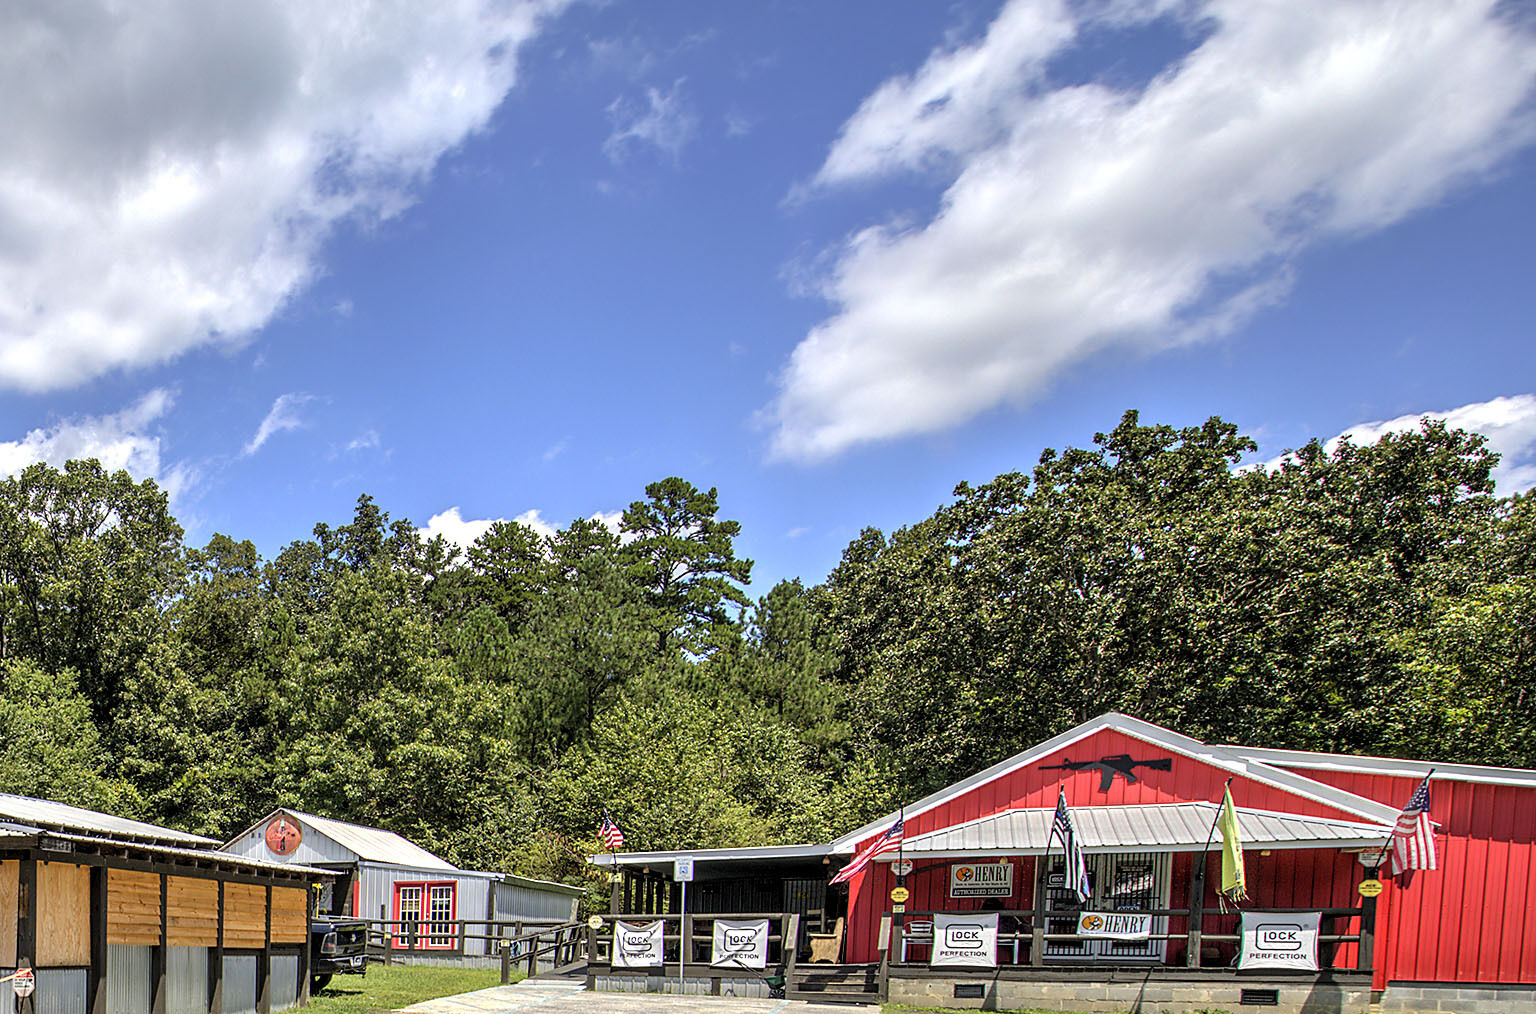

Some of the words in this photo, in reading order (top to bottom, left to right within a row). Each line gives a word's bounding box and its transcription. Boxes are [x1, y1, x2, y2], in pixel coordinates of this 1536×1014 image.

[975, 865, 1009, 882] HENRY
[1104, 915, 1146, 934] HENRY
[1249, 952, 1307, 960] PERFECTION
